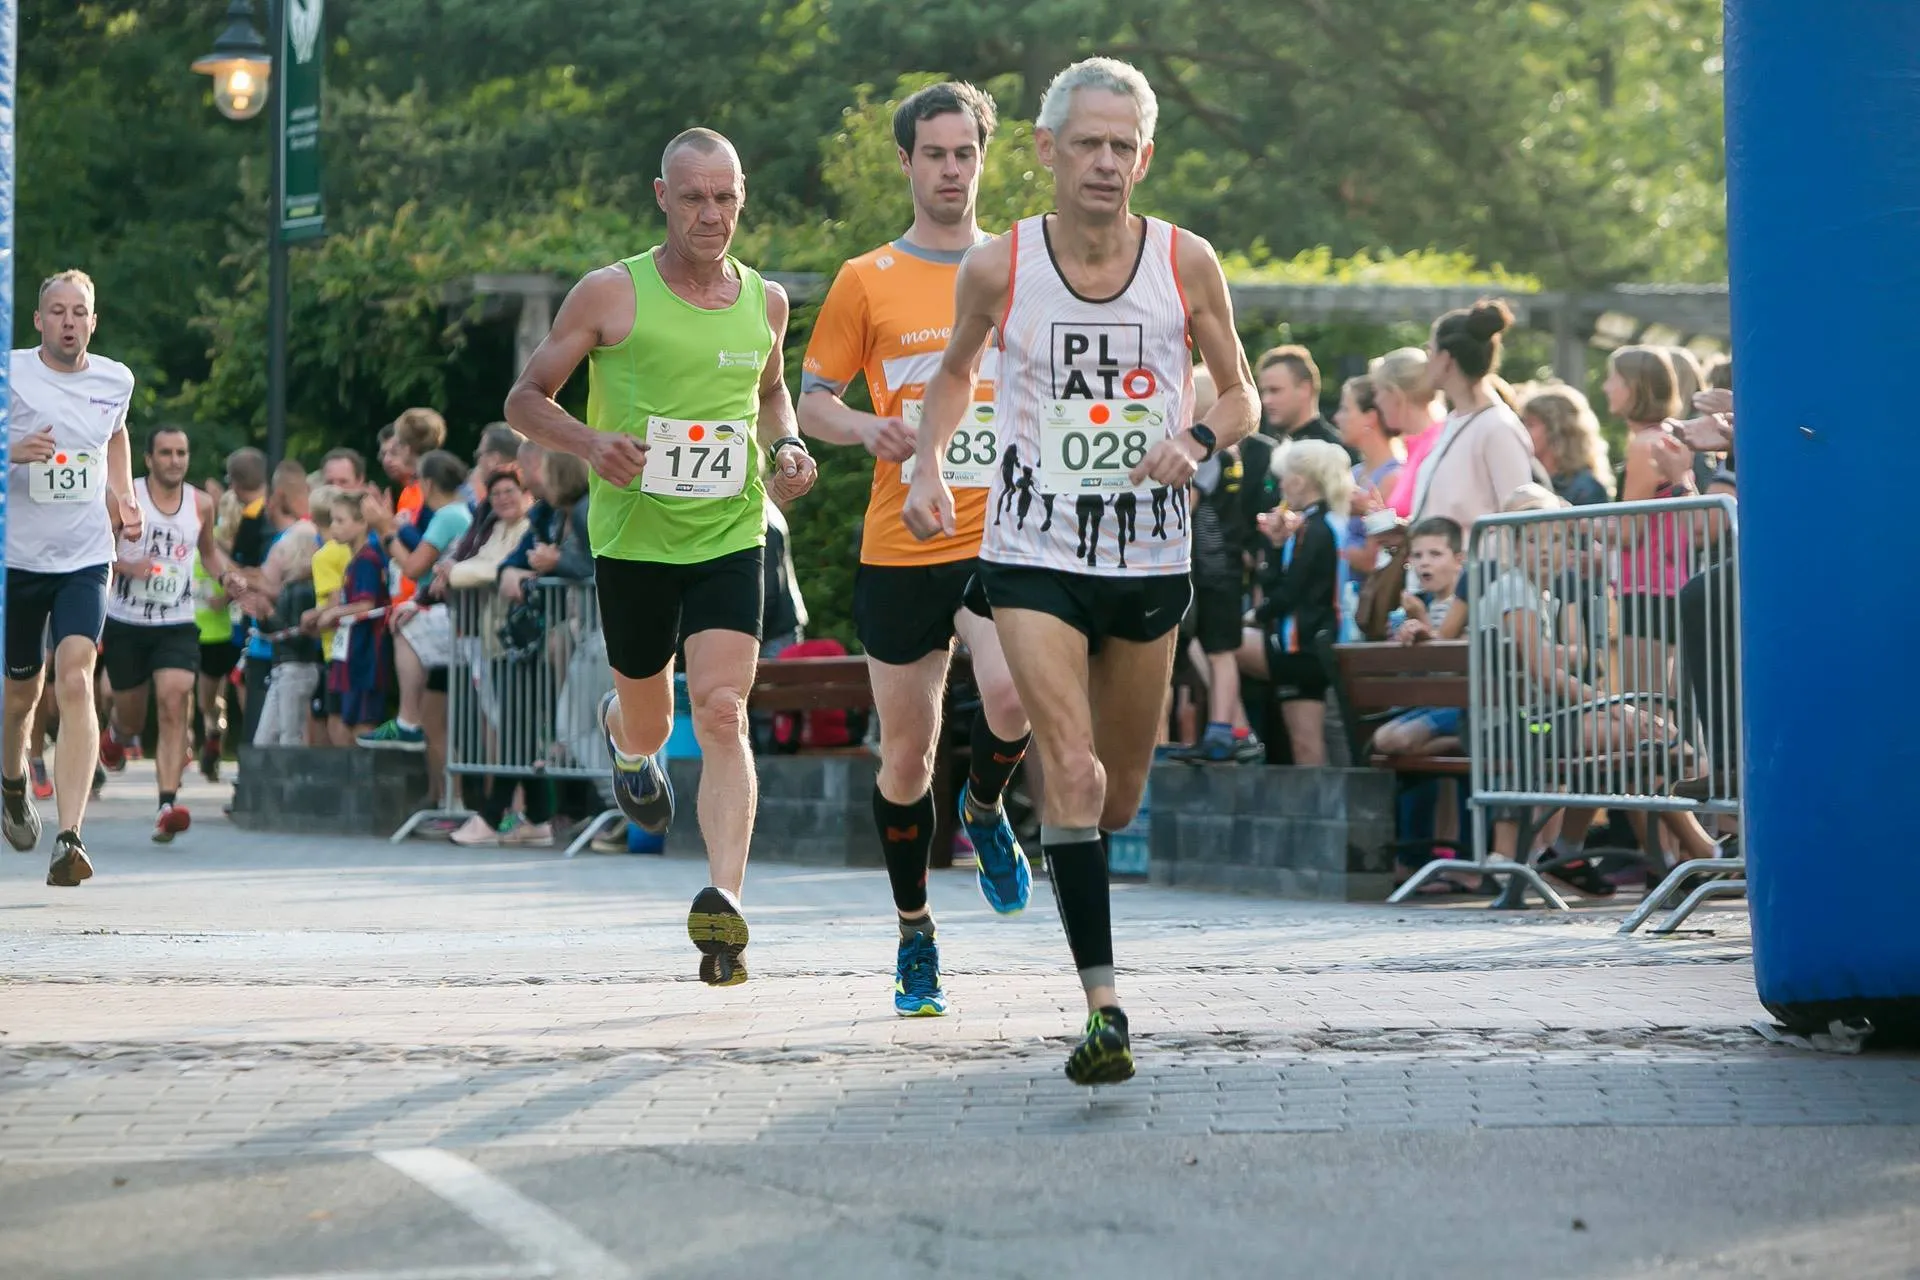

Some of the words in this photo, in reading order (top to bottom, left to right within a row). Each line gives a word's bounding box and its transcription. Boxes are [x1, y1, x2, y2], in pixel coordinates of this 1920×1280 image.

[1064, 333, 1118, 365] PL
[1061, 368, 1156, 399] ATO
[665, 446, 731, 478] 174
[945, 430, 997, 465] 83
[1062, 430, 1147, 471] 028
[44, 467, 87, 490] 131
